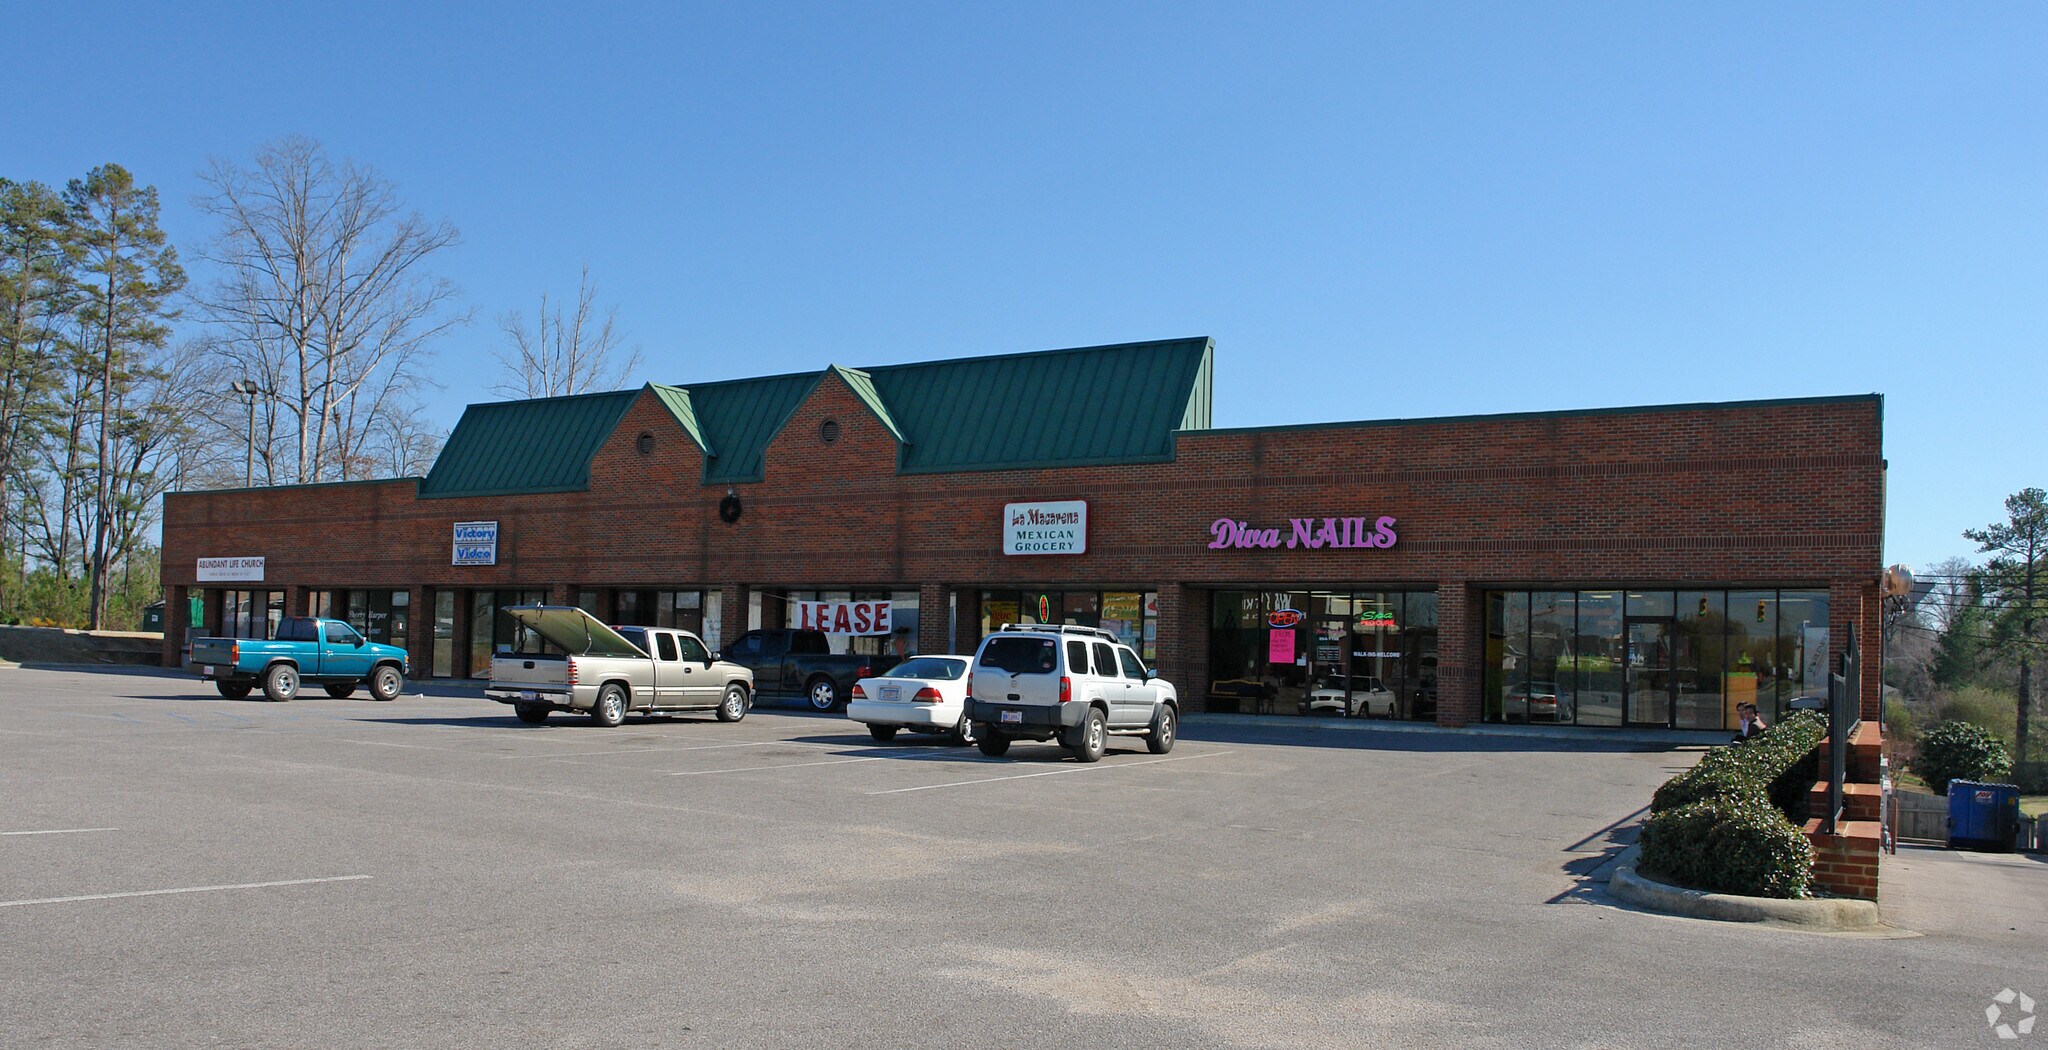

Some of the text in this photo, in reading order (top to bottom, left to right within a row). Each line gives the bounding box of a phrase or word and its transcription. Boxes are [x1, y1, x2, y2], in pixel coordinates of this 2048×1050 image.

[1012, 508, 1079, 526] La Macarena
[455, 527, 495, 541] Victory
[1016, 530, 1074, 540] MEXICAN
[1208, 516, 1397, 549] Diva NAILS
[456, 546, 491, 560] Video
[1015, 542, 1074, 551] GROCERY
[199, 559, 264, 569] ABUNDANT LIFE CHURCH
[800, 603, 889, 633] LEASE
[1269, 610, 1299, 625] OPEN
[1361, 610, 1393, 620] Spa
